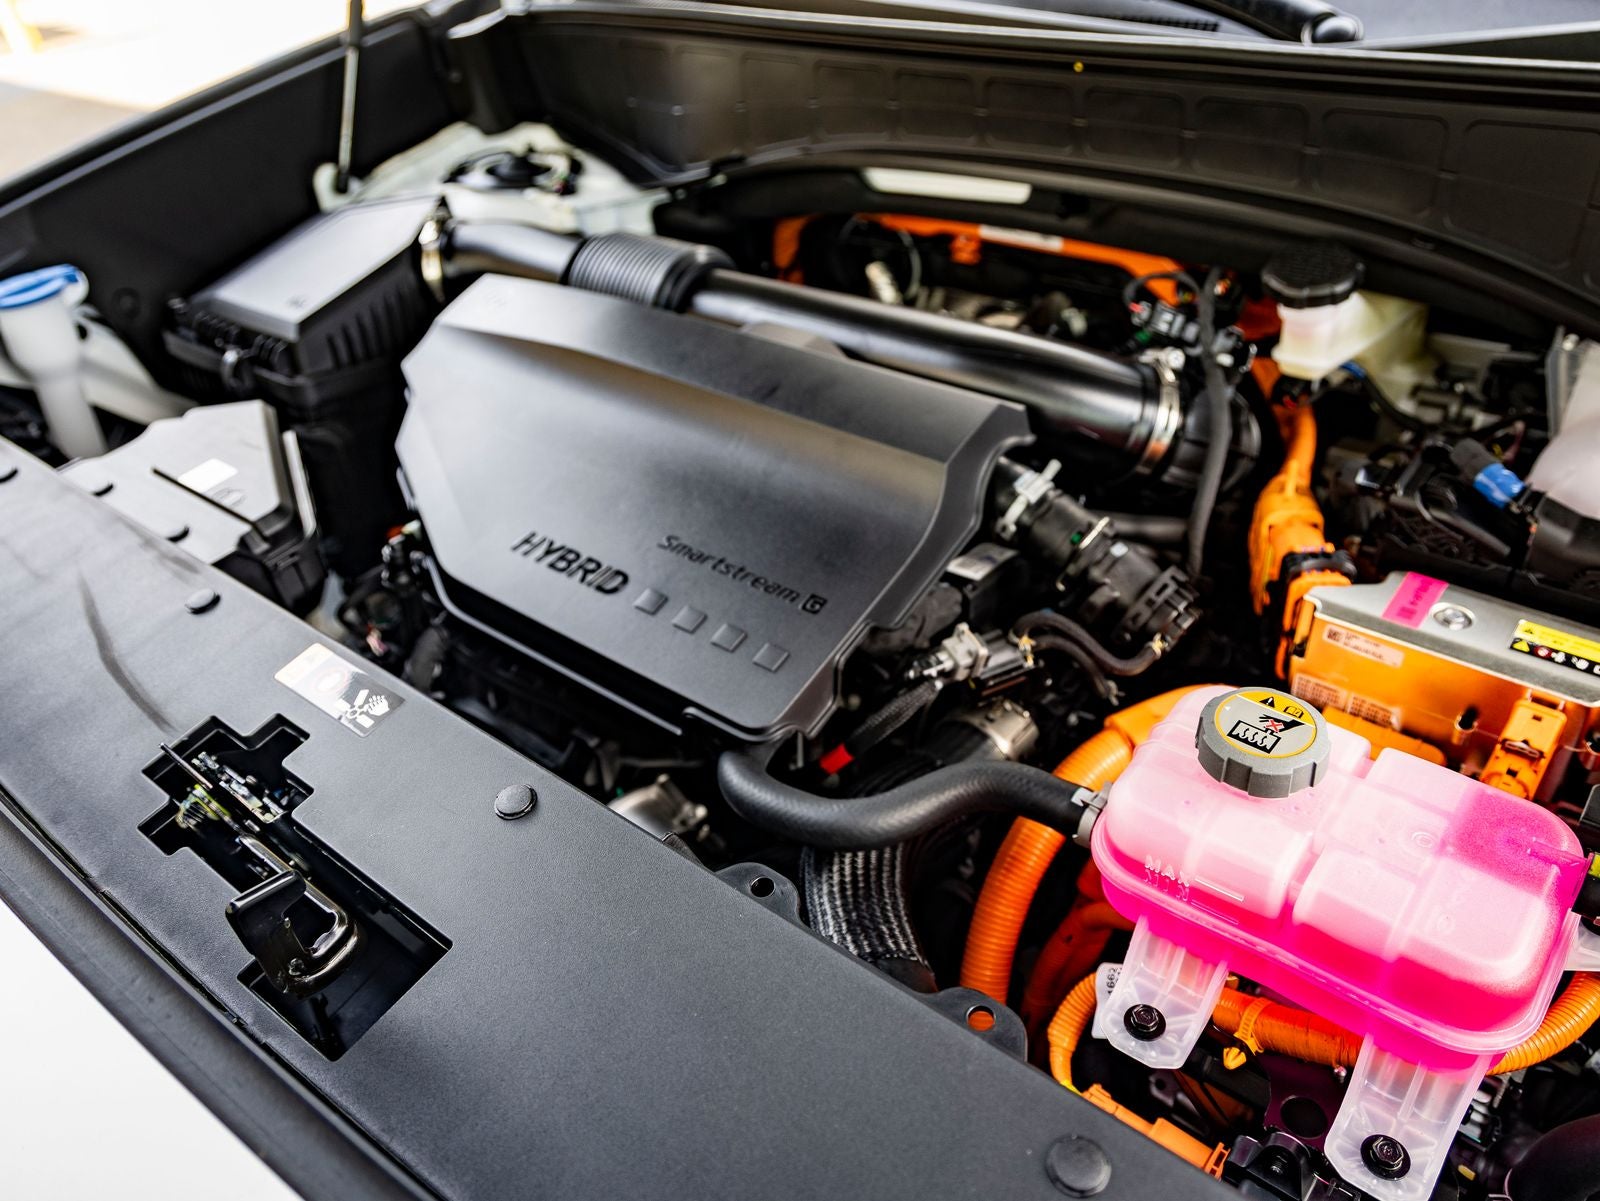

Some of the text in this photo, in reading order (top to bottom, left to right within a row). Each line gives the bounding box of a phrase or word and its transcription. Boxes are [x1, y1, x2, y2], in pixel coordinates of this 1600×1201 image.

[510, 531, 629, 594] HYBRID
[657, 534, 801, 603] Smartstream
[1144, 855, 1190, 887] MAX
